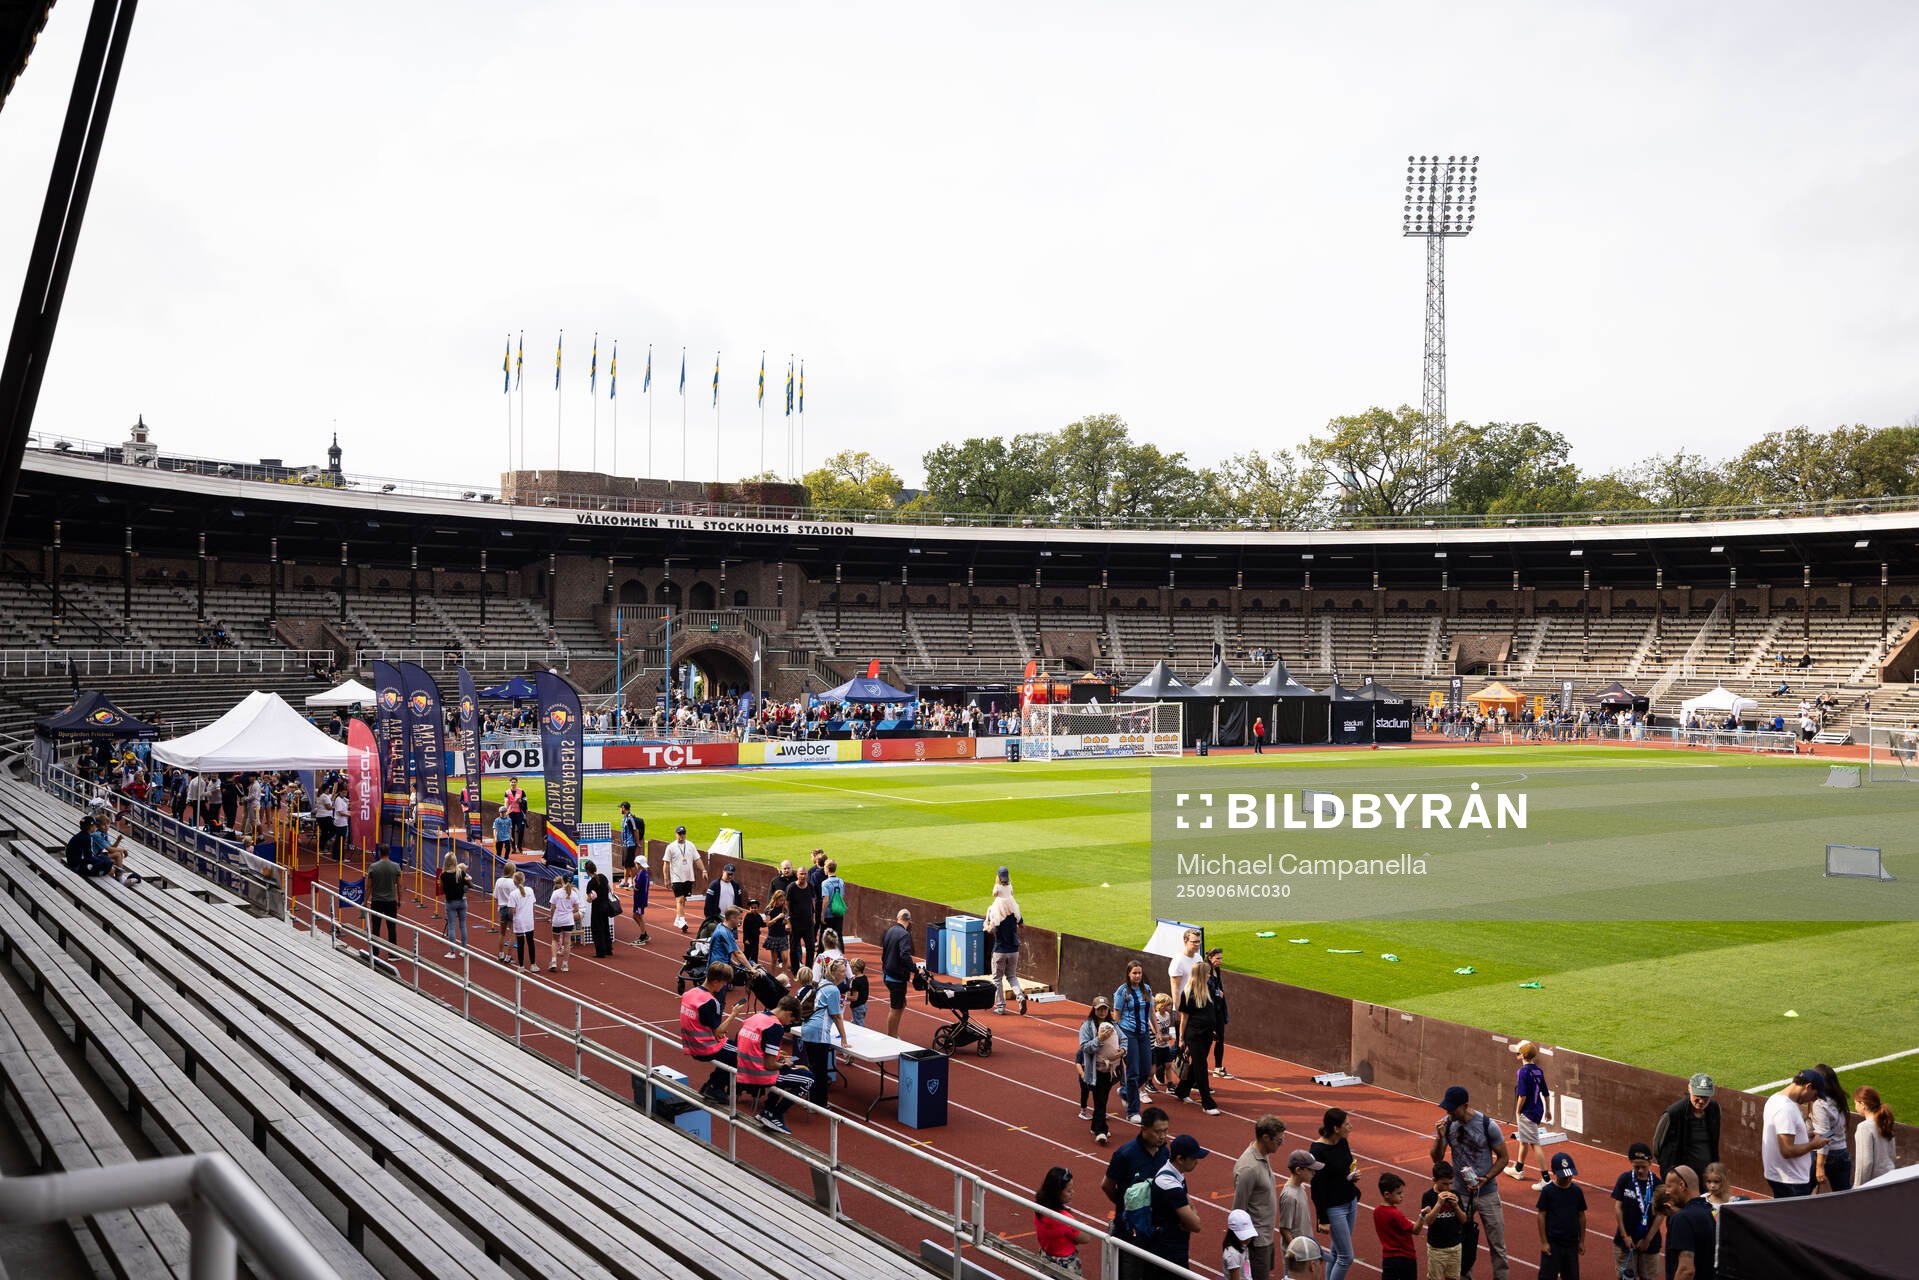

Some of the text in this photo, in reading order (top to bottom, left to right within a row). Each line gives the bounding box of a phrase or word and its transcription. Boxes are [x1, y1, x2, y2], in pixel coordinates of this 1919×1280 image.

[576, 512, 854, 536] VÄLKOMMEN TILL STOCKHOLMS STADION
[1343, 719, 1364, 727] stadium
[1376, 717, 1409, 729] stadium
[784, 742, 831, 756] weber
[643, 746, 702, 767] TCL
